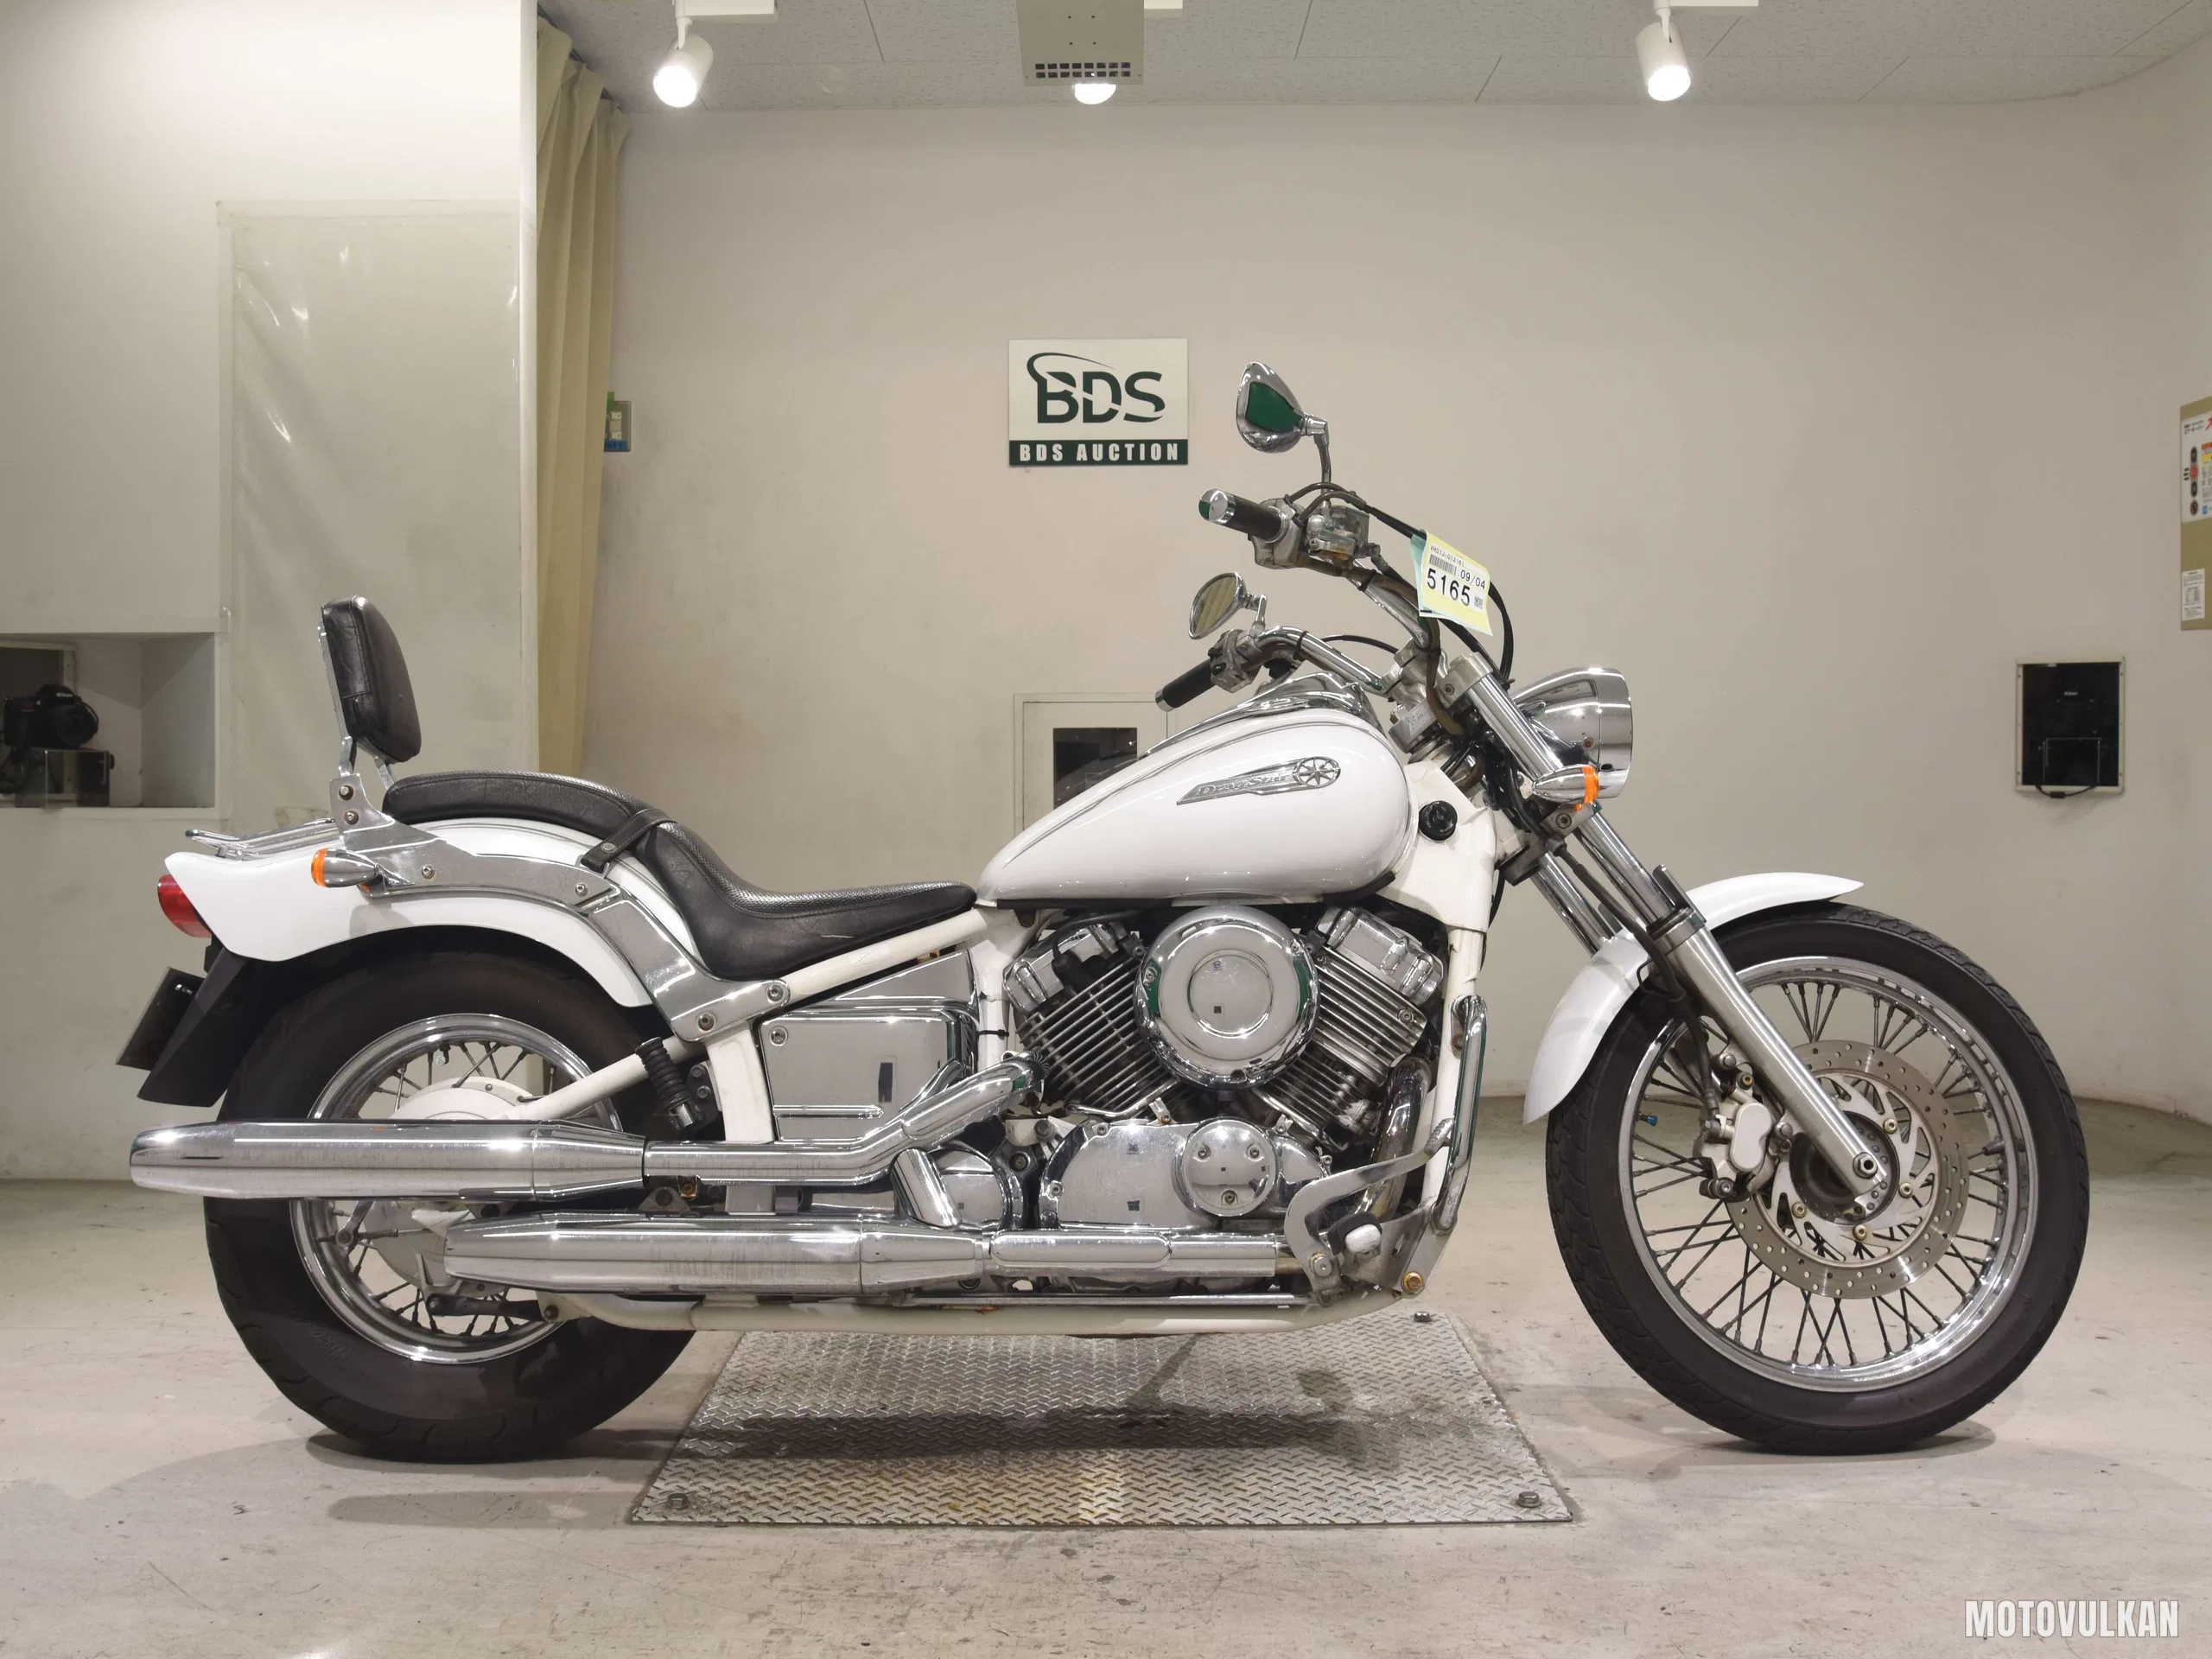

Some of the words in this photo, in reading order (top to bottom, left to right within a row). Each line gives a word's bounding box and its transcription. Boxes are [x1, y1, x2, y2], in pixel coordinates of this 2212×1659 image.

[1027, 352, 1166, 423] BDS
[1020, 443, 1064, 461] BDS
[1076, 442, 1179, 461] AUCTION
[1427, 568, 1470, 607] 5165
[1460, 569, 1485, 589] 09/04
